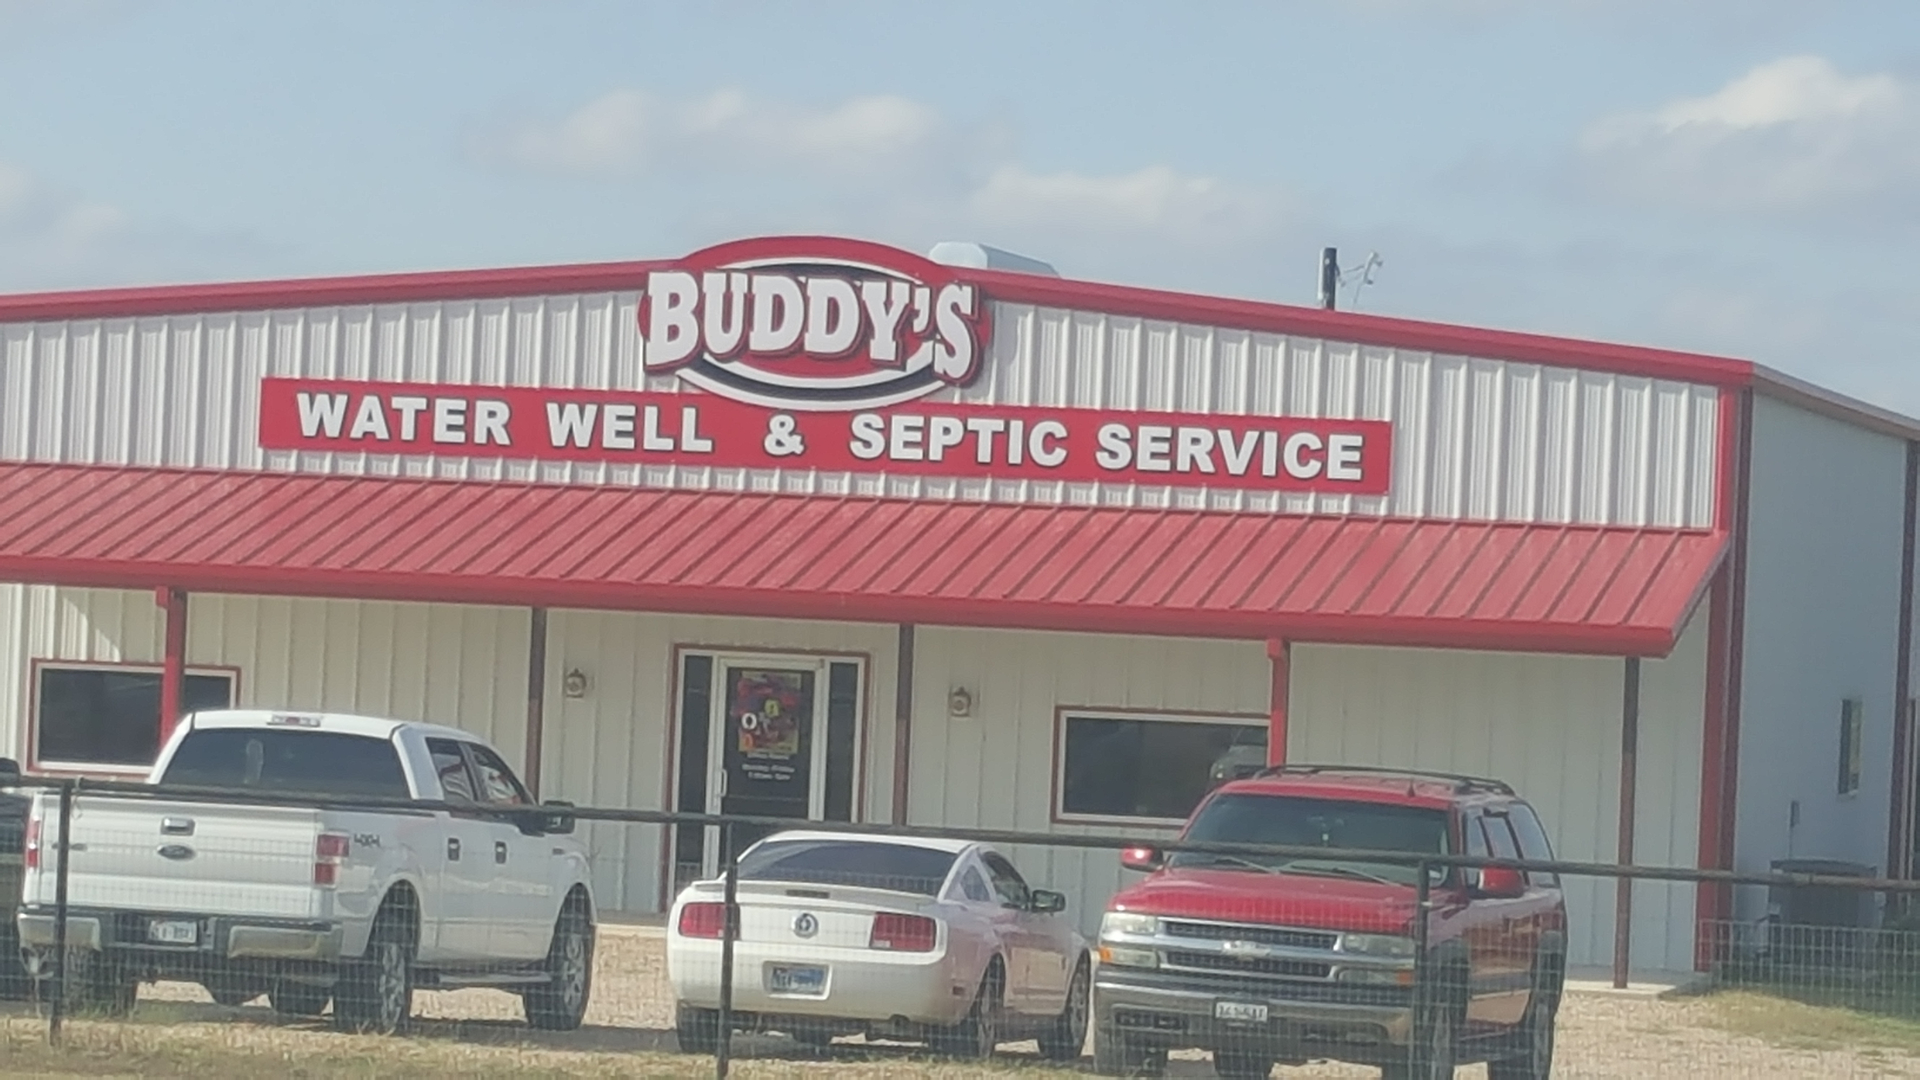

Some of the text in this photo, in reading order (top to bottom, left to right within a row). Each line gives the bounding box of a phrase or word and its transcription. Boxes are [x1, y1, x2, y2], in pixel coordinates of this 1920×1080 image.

[645, 269, 973, 379] BUDDY'S
[296, 392, 1364, 480] WATER WELL & SEPTIC SERVICE
